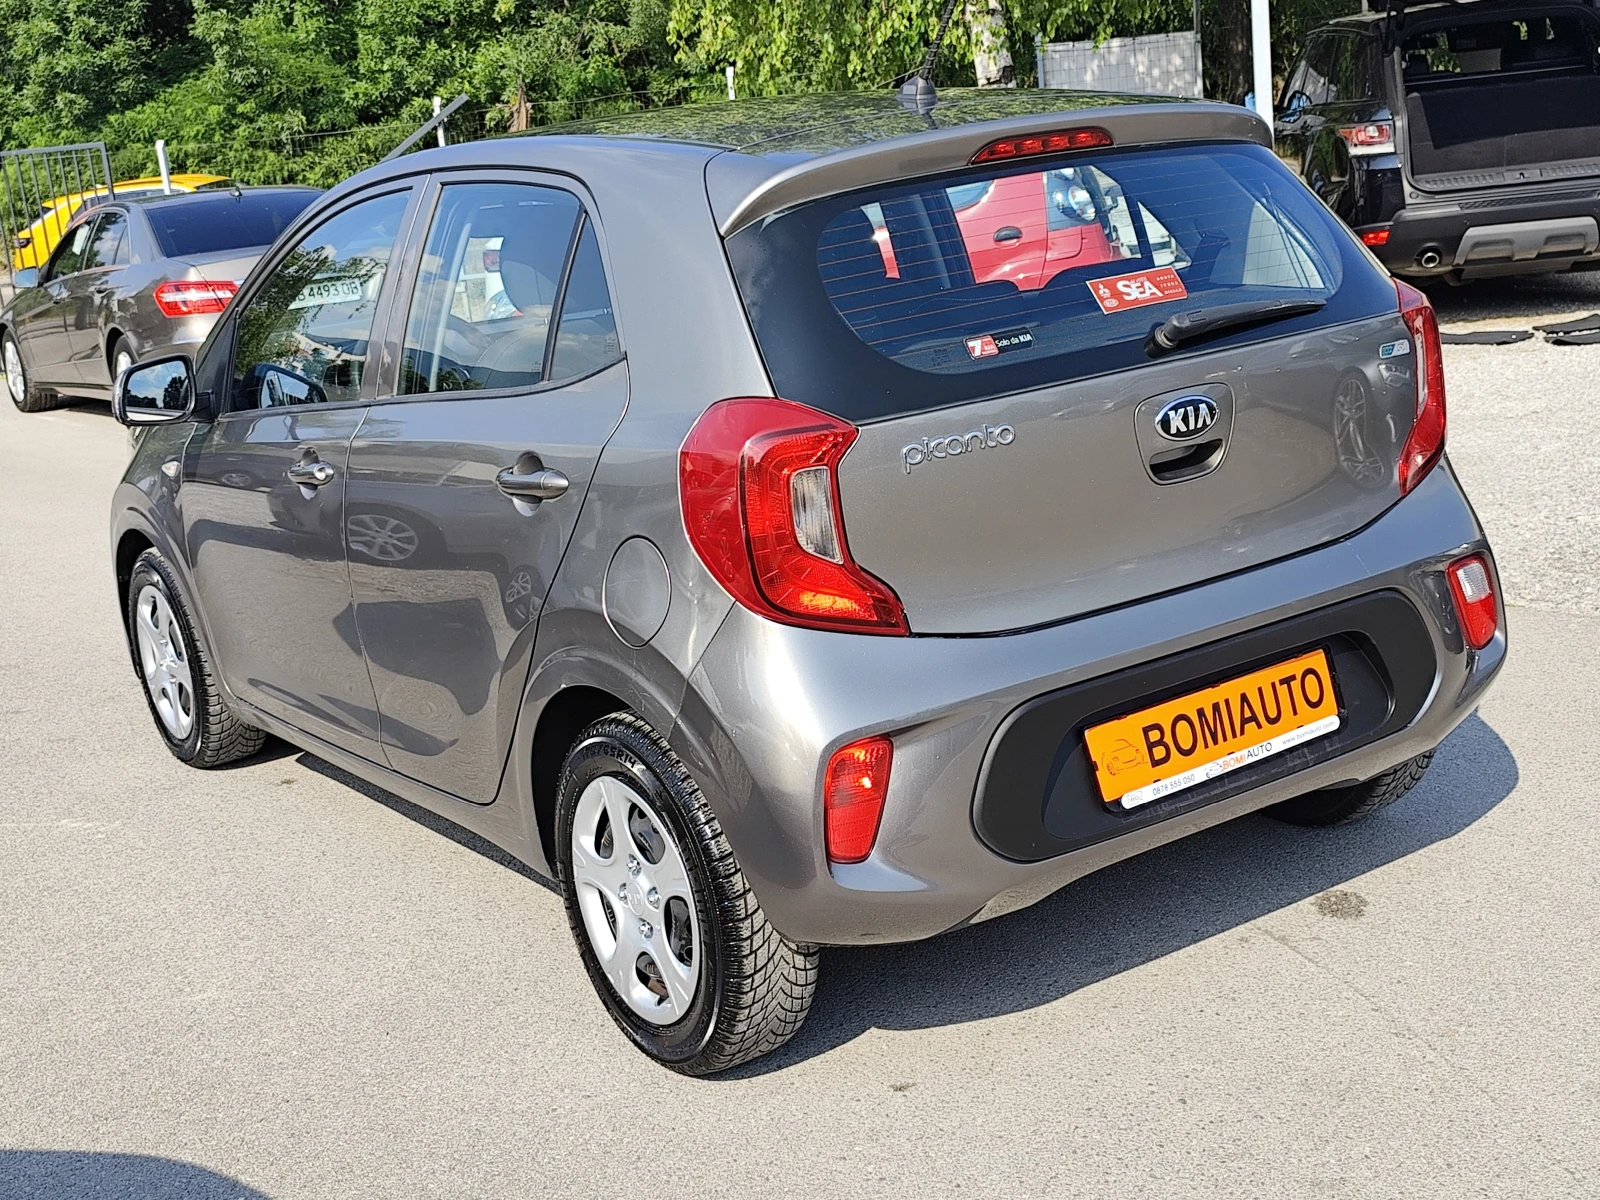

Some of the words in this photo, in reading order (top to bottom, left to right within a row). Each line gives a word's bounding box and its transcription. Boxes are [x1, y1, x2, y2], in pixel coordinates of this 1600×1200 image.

[308, 283, 340, 298] 4493
[1116, 280, 1164, 300] SEA
[967, 339, 982, 357] 7
[995, 338, 1010, 348] Solo
[1010, 336, 1020, 345] da
[1018, 333, 1033, 343] KIA
[1167, 402, 1212, 435] KIA
[901, 423, 1016, 474] picanto
[1142, 667, 1325, 769] BOMIAUTO
[1152, 783, 1169, 796] 0878
[1170, 779, 1182, 790] 555
[1183, 773, 1196, 785] 050
